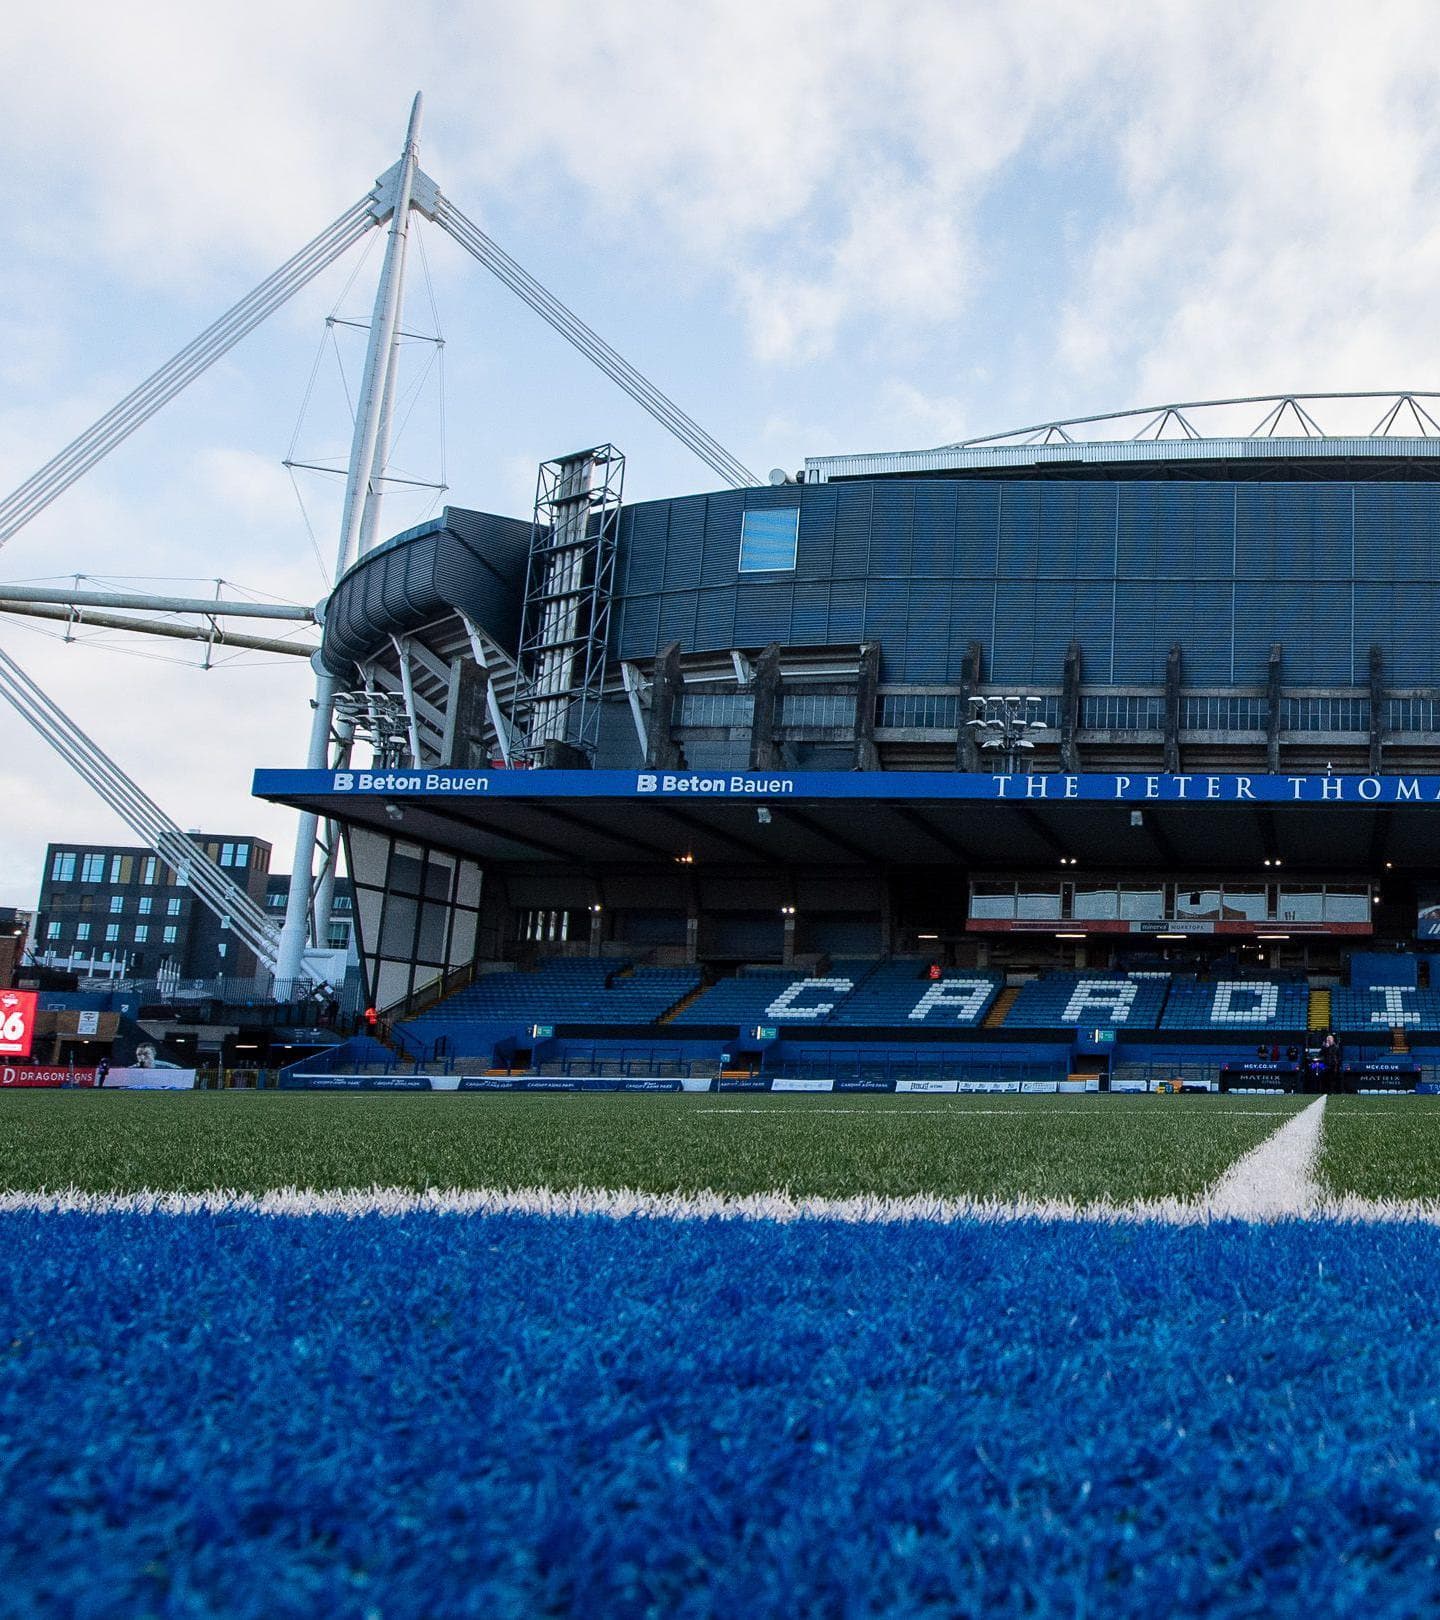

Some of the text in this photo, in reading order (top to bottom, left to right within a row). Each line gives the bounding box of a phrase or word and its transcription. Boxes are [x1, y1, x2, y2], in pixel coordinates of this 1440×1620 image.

[358, 774, 421, 790] Beton
[426, 775, 489, 790] Bauen
[662, 775, 726, 792] Beton
[731, 776, 793, 793] Bauen
[993, 775, 1078, 798] THE
[1116, 776, 1257, 799] PETER
[20, 1071, 94, 1082] DRAGONSGNS
